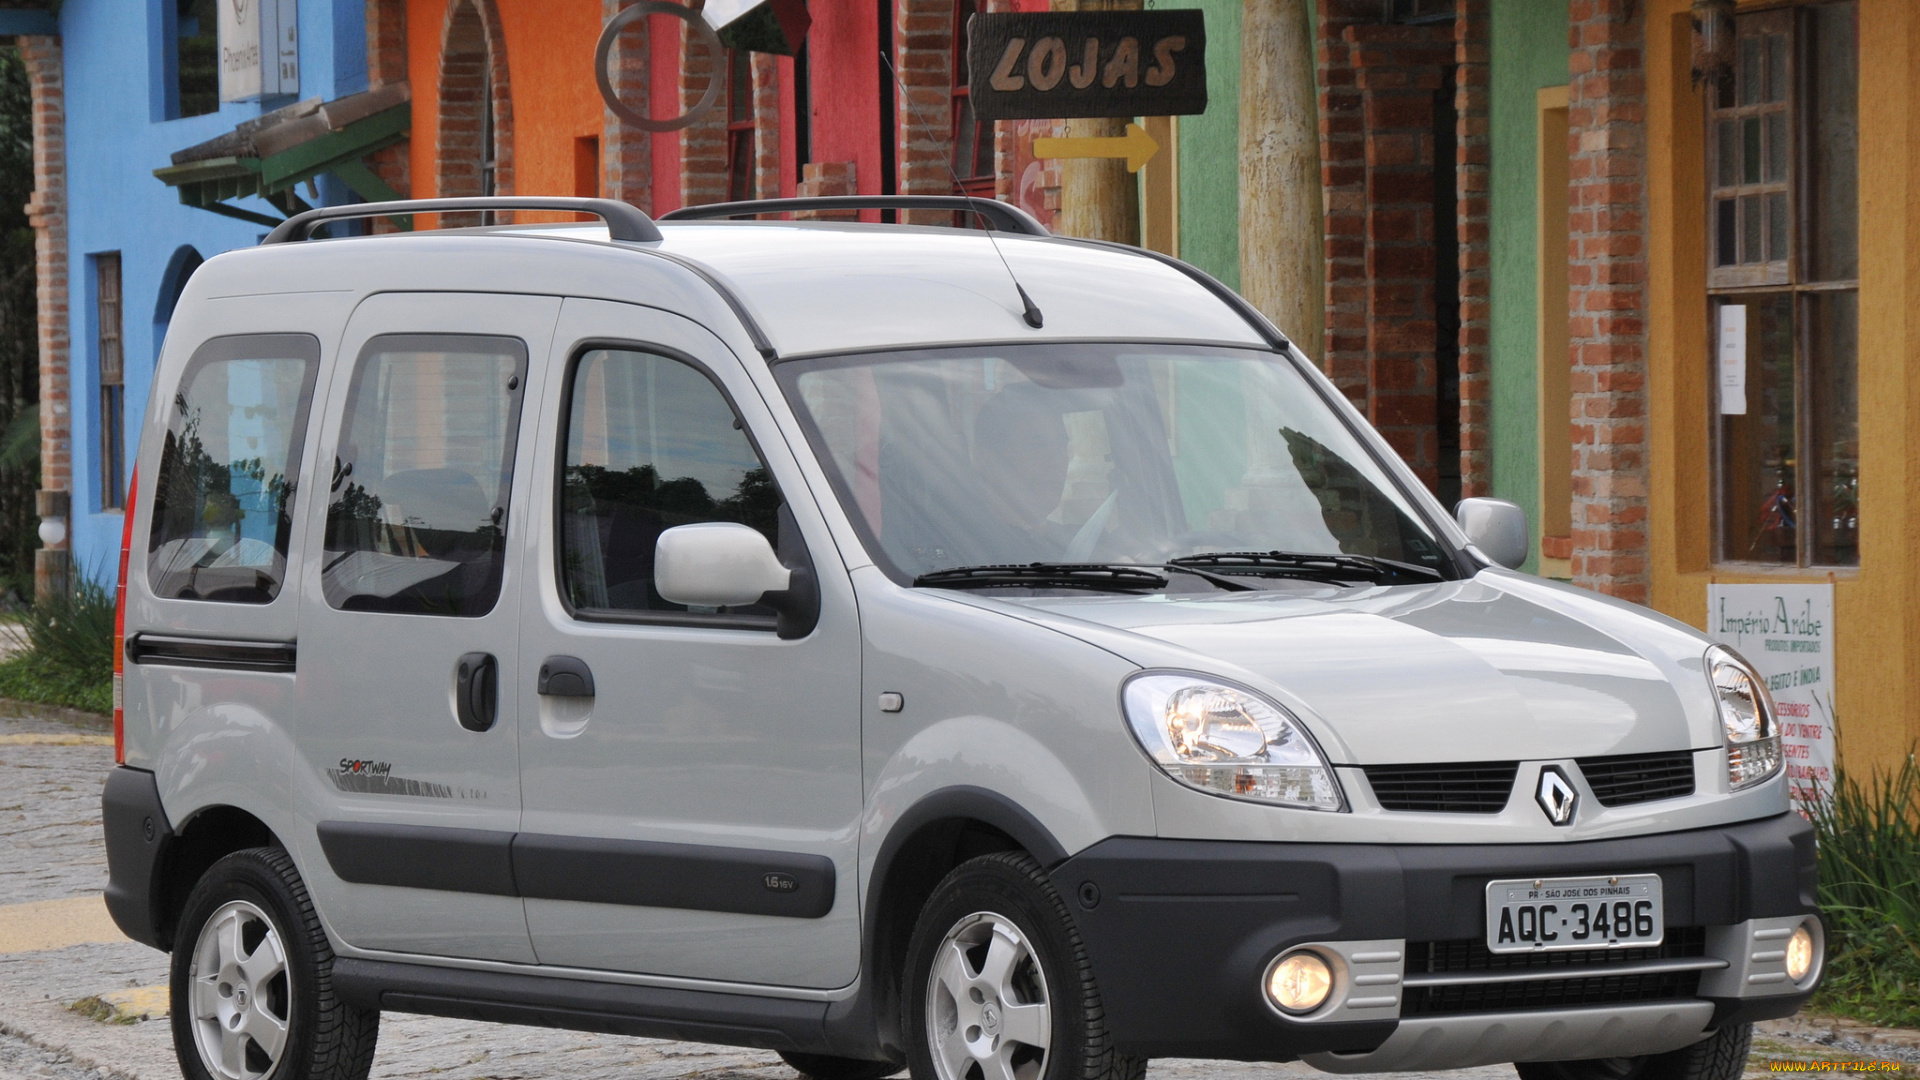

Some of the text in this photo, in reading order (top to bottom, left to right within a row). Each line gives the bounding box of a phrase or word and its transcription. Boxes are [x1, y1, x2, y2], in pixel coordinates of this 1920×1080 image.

[989, 35, 1187, 92] LOJAS
[1720, 596, 1823, 648] Império Arábe
[1793, 670, 1799, 687] E
[340, 758, 391, 783] SPORTWAY
[764, 875, 779, 888] 1.6
[1528, 891, 1539, 899] PR
[1545, 889, 1561, 898] SÃO
[1562, 888, 1582, 898] JOSÉ
[1600, 886, 1631, 895] PINHAIS
